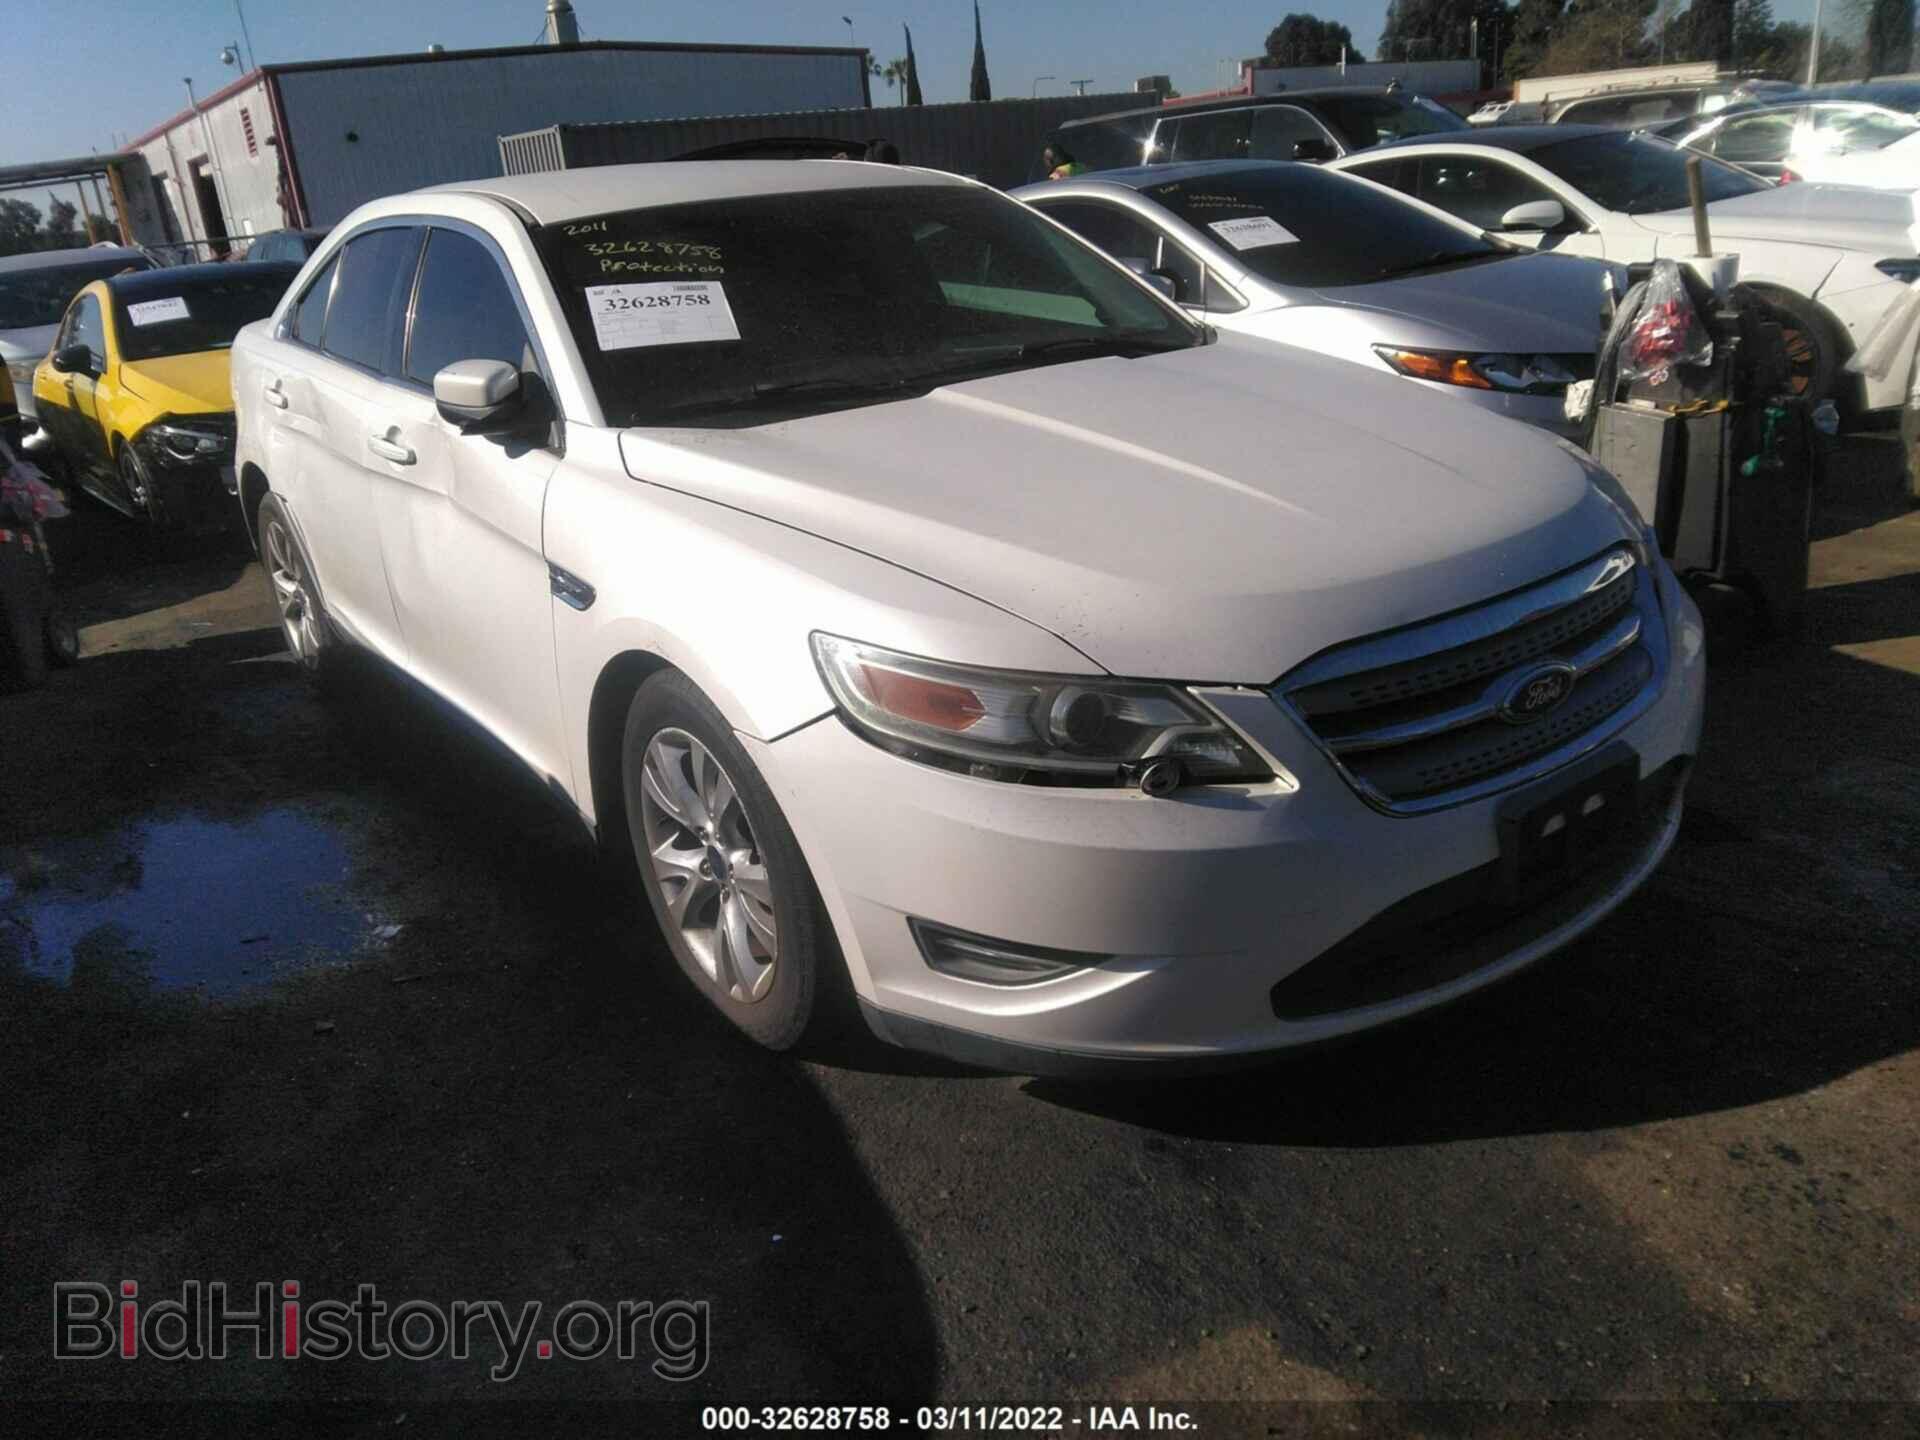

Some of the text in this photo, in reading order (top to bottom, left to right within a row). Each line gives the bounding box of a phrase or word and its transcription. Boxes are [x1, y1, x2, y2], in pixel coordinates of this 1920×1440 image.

[563, 220, 608, 236] 2011
[584, 240, 723, 260] 32628758
[604, 293, 712, 312] 32628758
